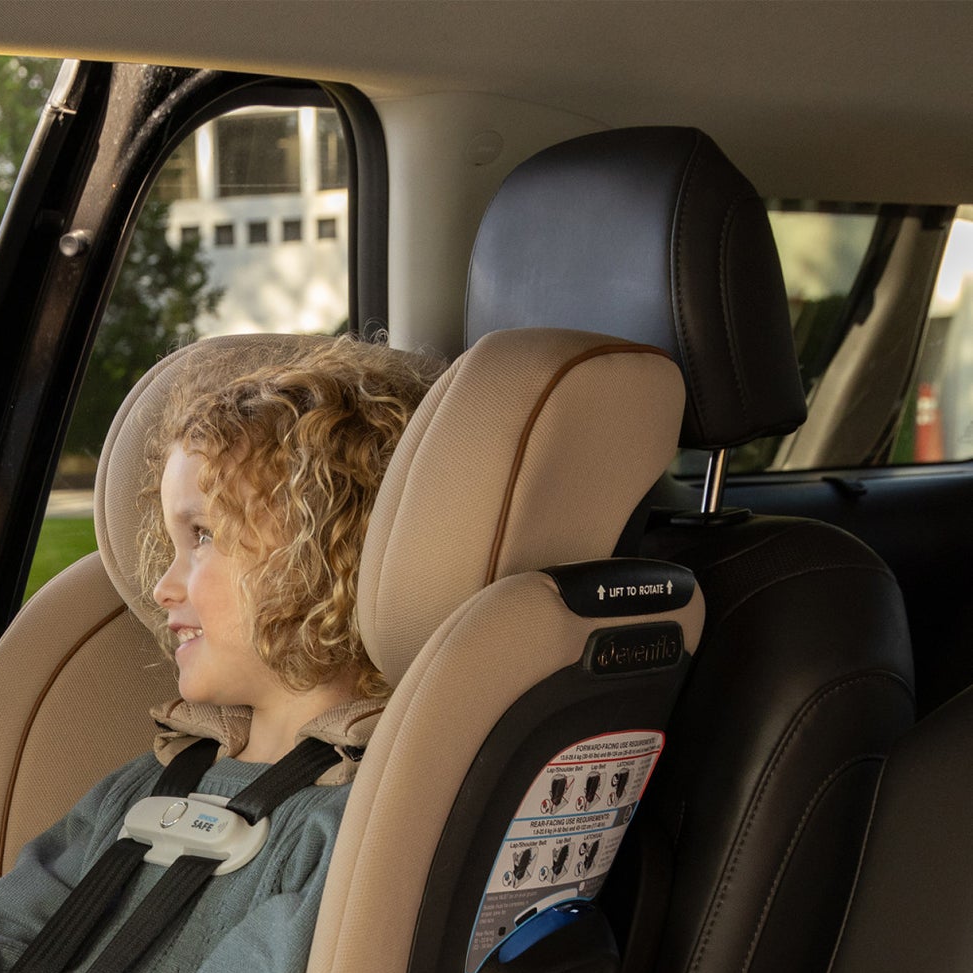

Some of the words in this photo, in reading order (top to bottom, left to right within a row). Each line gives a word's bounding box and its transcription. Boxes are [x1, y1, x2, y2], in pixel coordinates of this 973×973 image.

[609, 587, 624, 598] LIFT
[627, 586, 637, 597] TO
[639, 584, 664, 595] ROTATE
[191, 819, 214, 832] SAFE
[565, 817, 576, 825] USE
